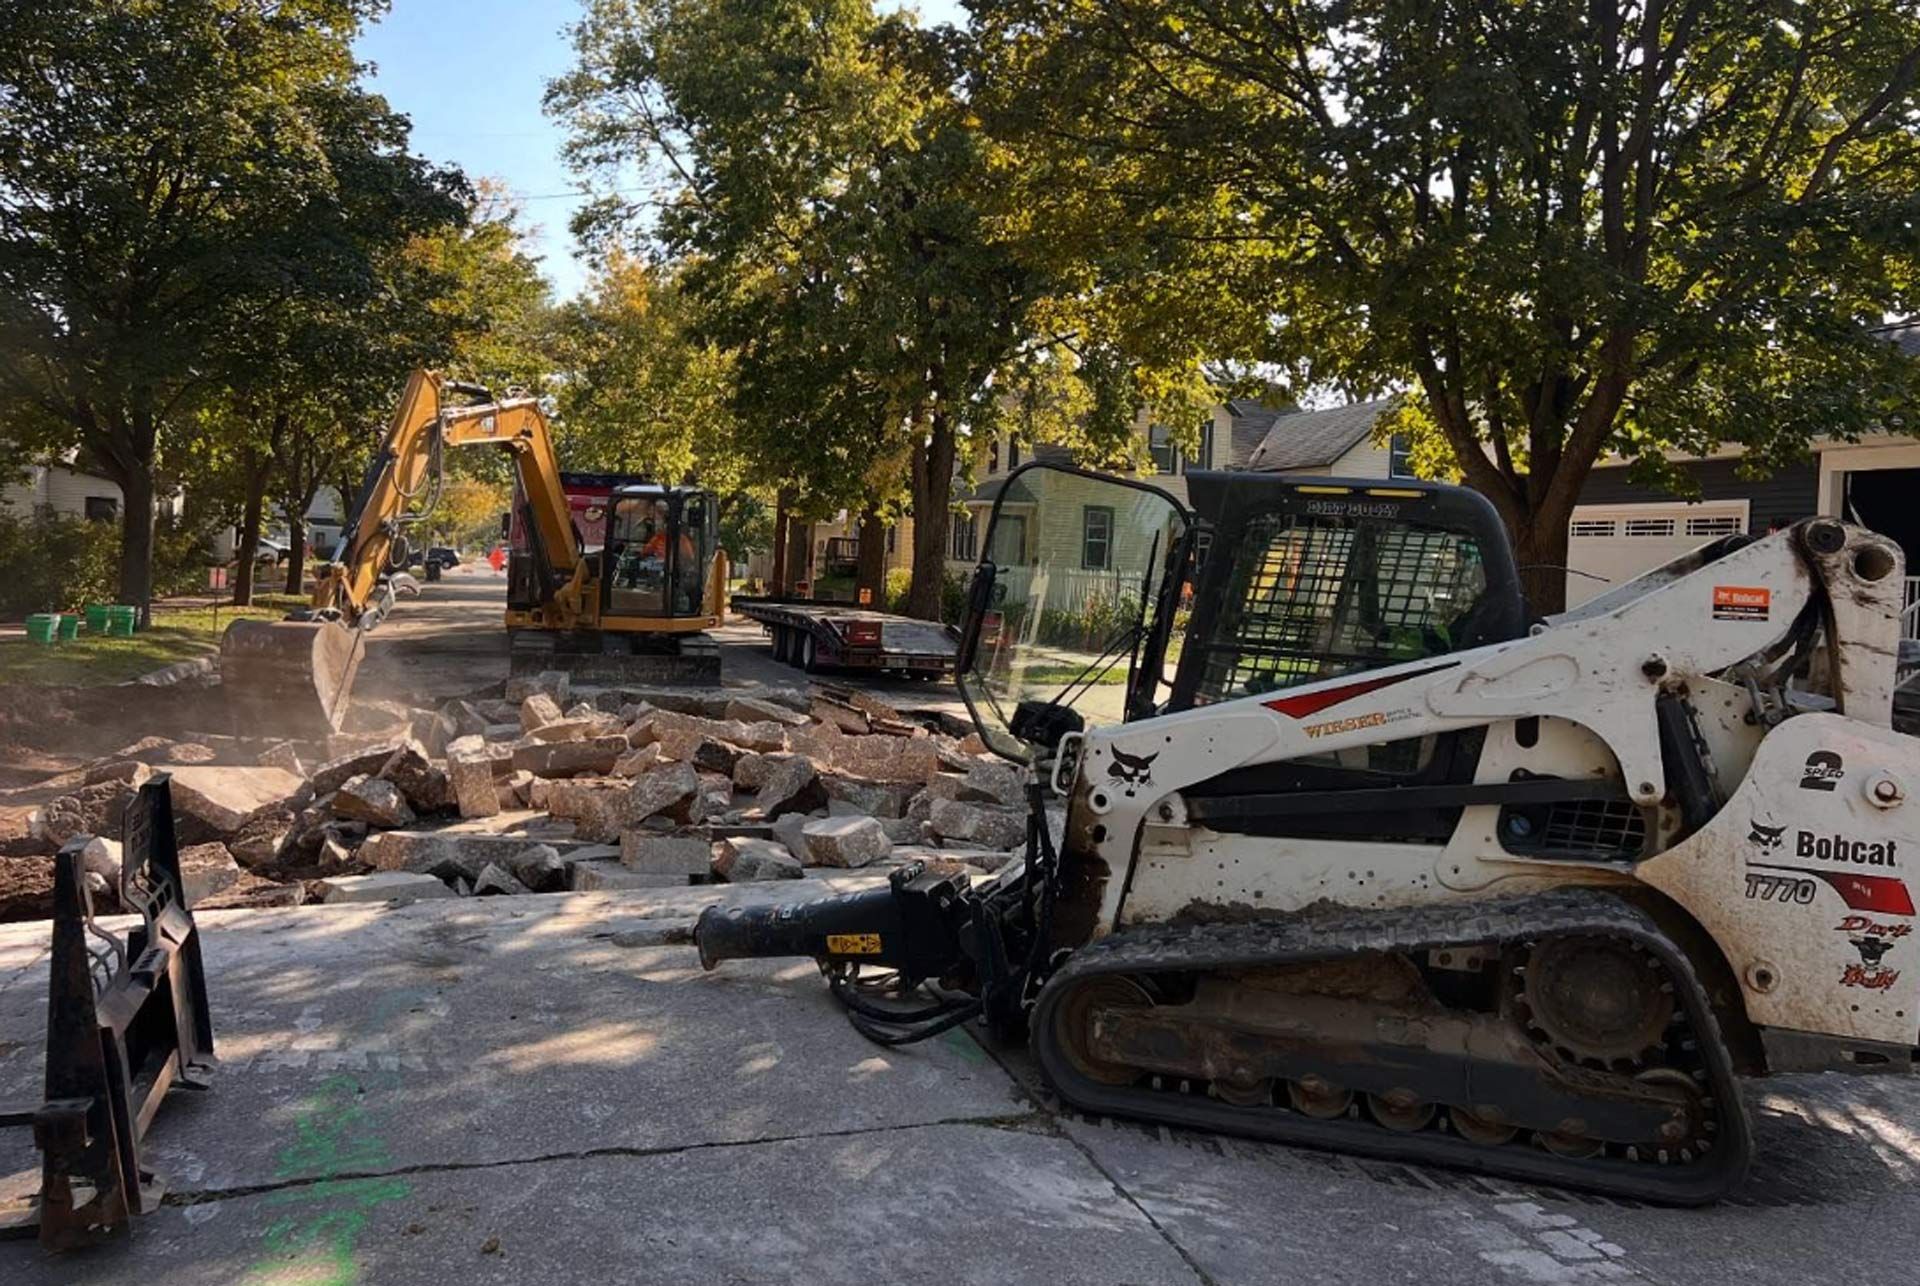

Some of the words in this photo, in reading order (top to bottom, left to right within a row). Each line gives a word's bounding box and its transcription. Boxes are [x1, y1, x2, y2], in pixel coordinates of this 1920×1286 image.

[1800, 750, 1843, 792] 2
[1796, 831, 1897, 867] Bobcat
[1745, 873, 1817, 904] T770
